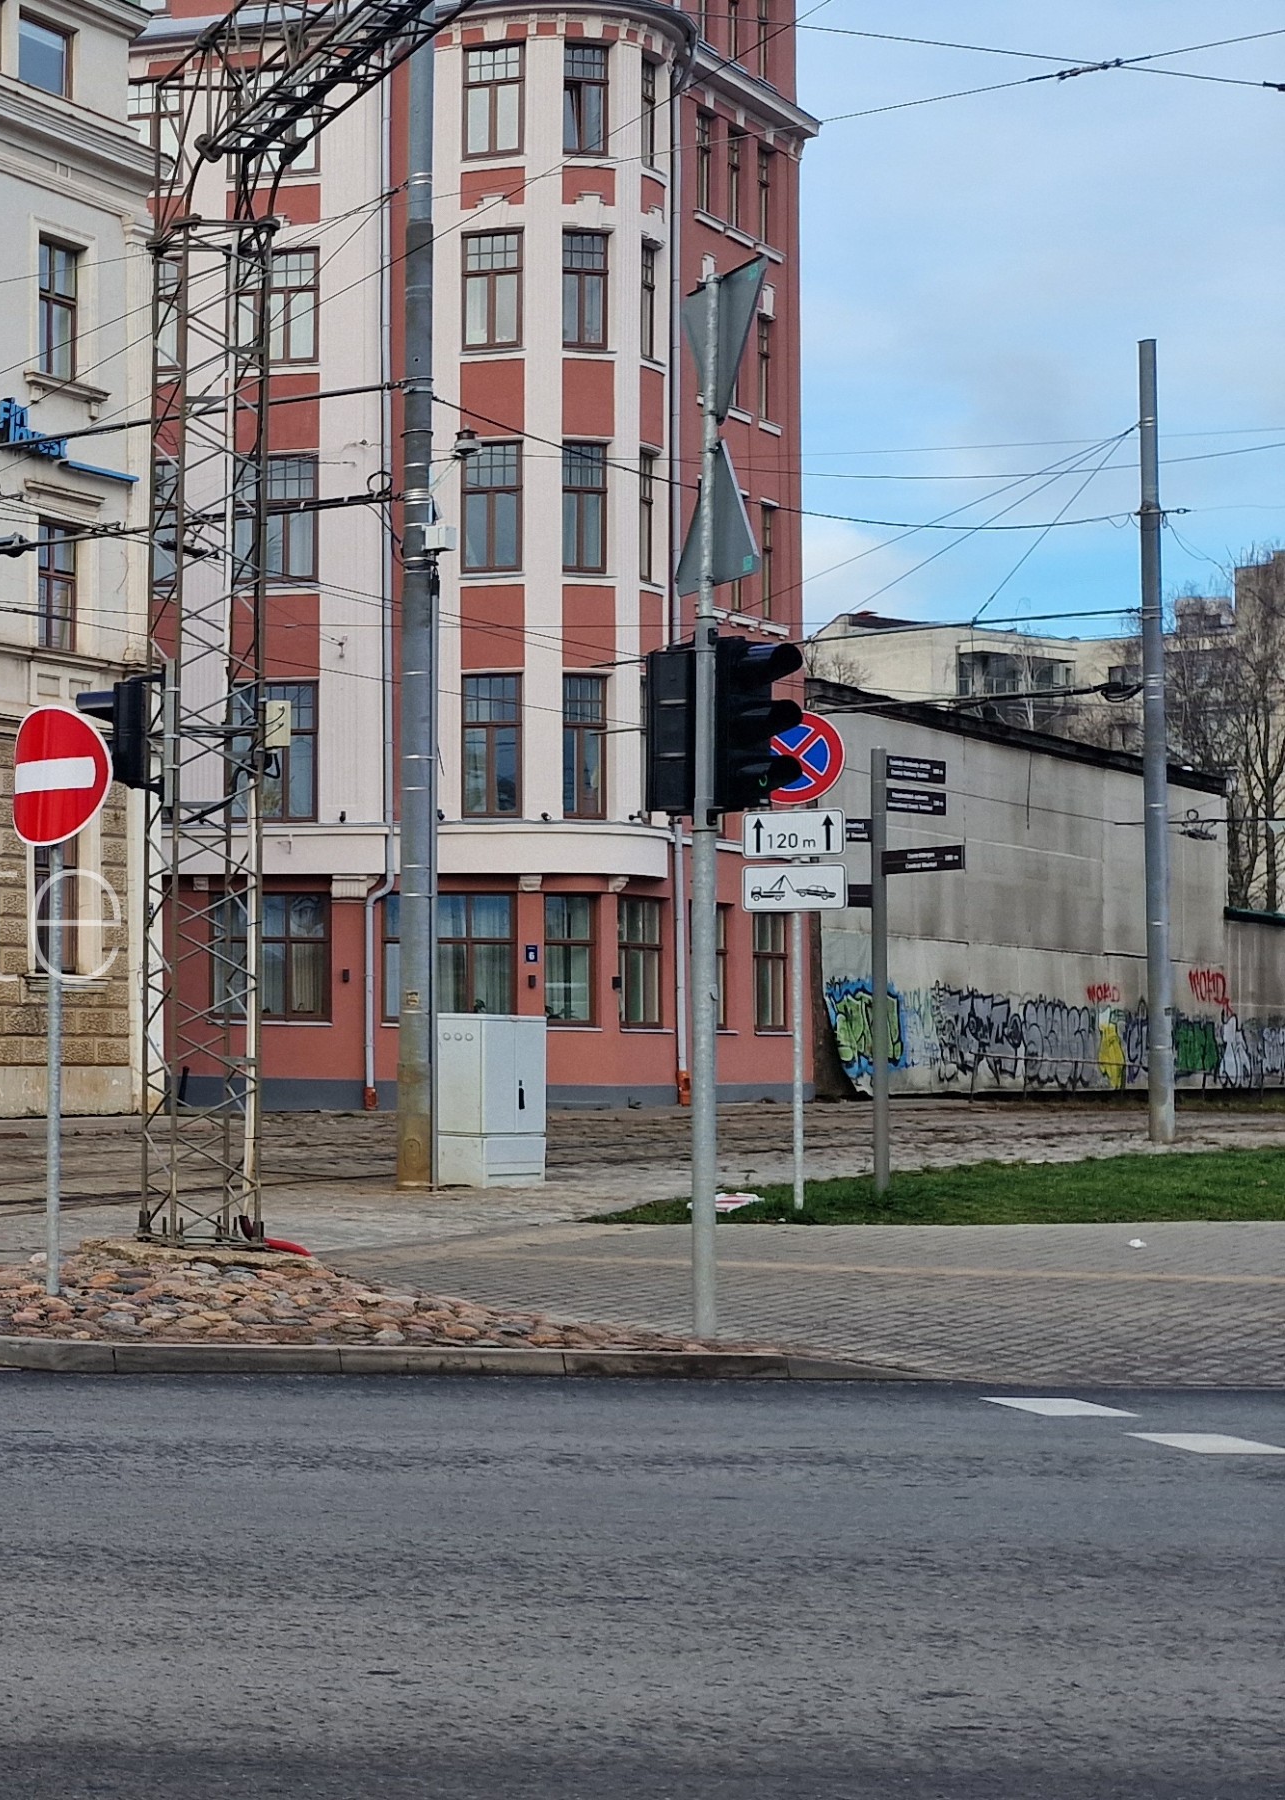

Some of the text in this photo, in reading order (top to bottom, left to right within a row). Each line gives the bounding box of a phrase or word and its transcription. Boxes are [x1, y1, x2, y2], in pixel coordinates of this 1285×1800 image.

[767, 833, 816, 849] 120 m
[528, 951, 536, 961] 6
